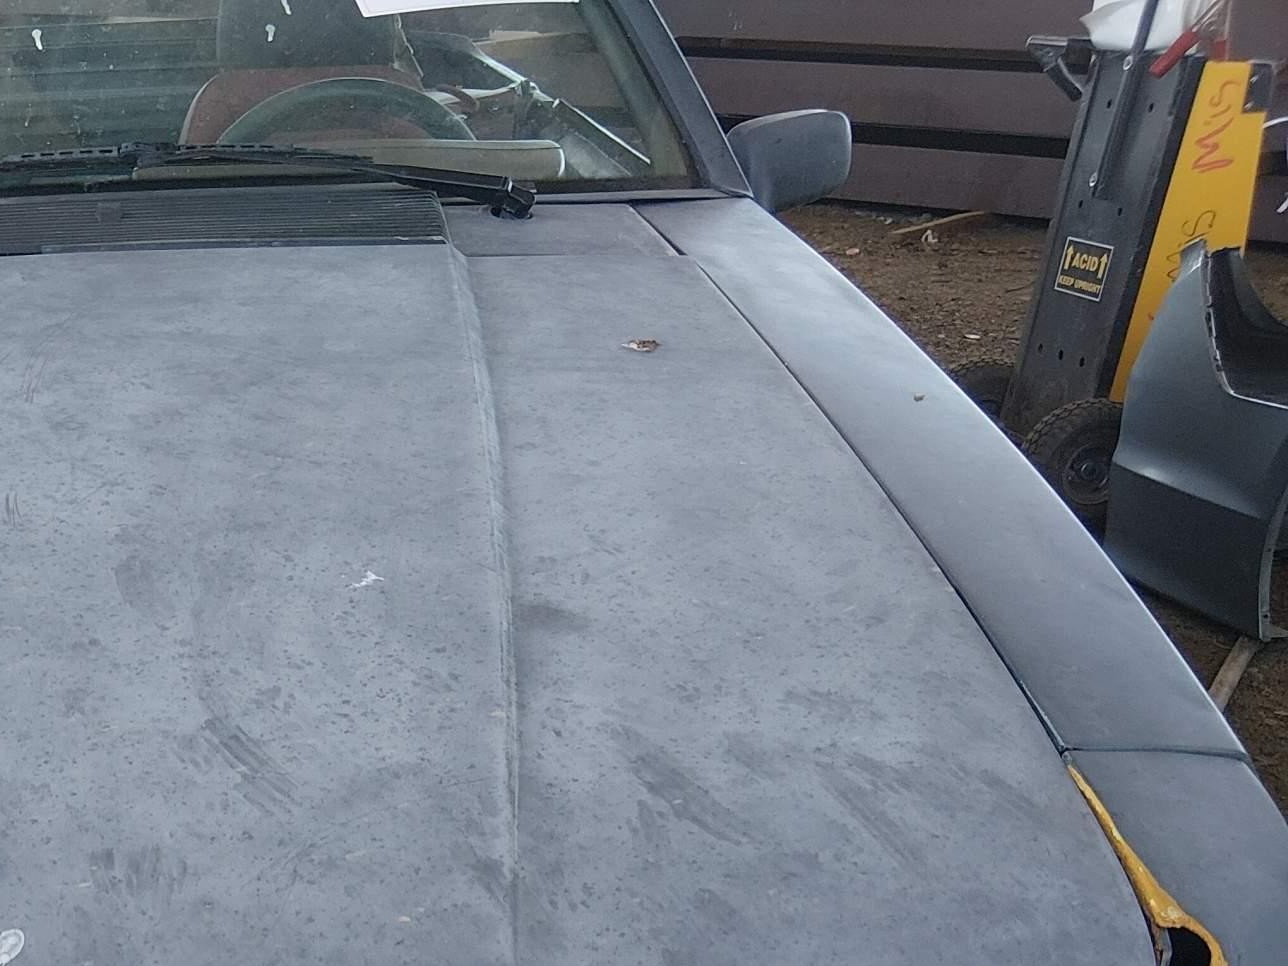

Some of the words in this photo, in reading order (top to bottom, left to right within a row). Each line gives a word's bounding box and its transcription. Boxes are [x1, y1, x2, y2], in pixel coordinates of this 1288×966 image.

[1071, 252, 1099, 272] ACID
[1058, 275, 1075, 287] KEEP
[1074, 279, 1102, 294] UPRIGHT
